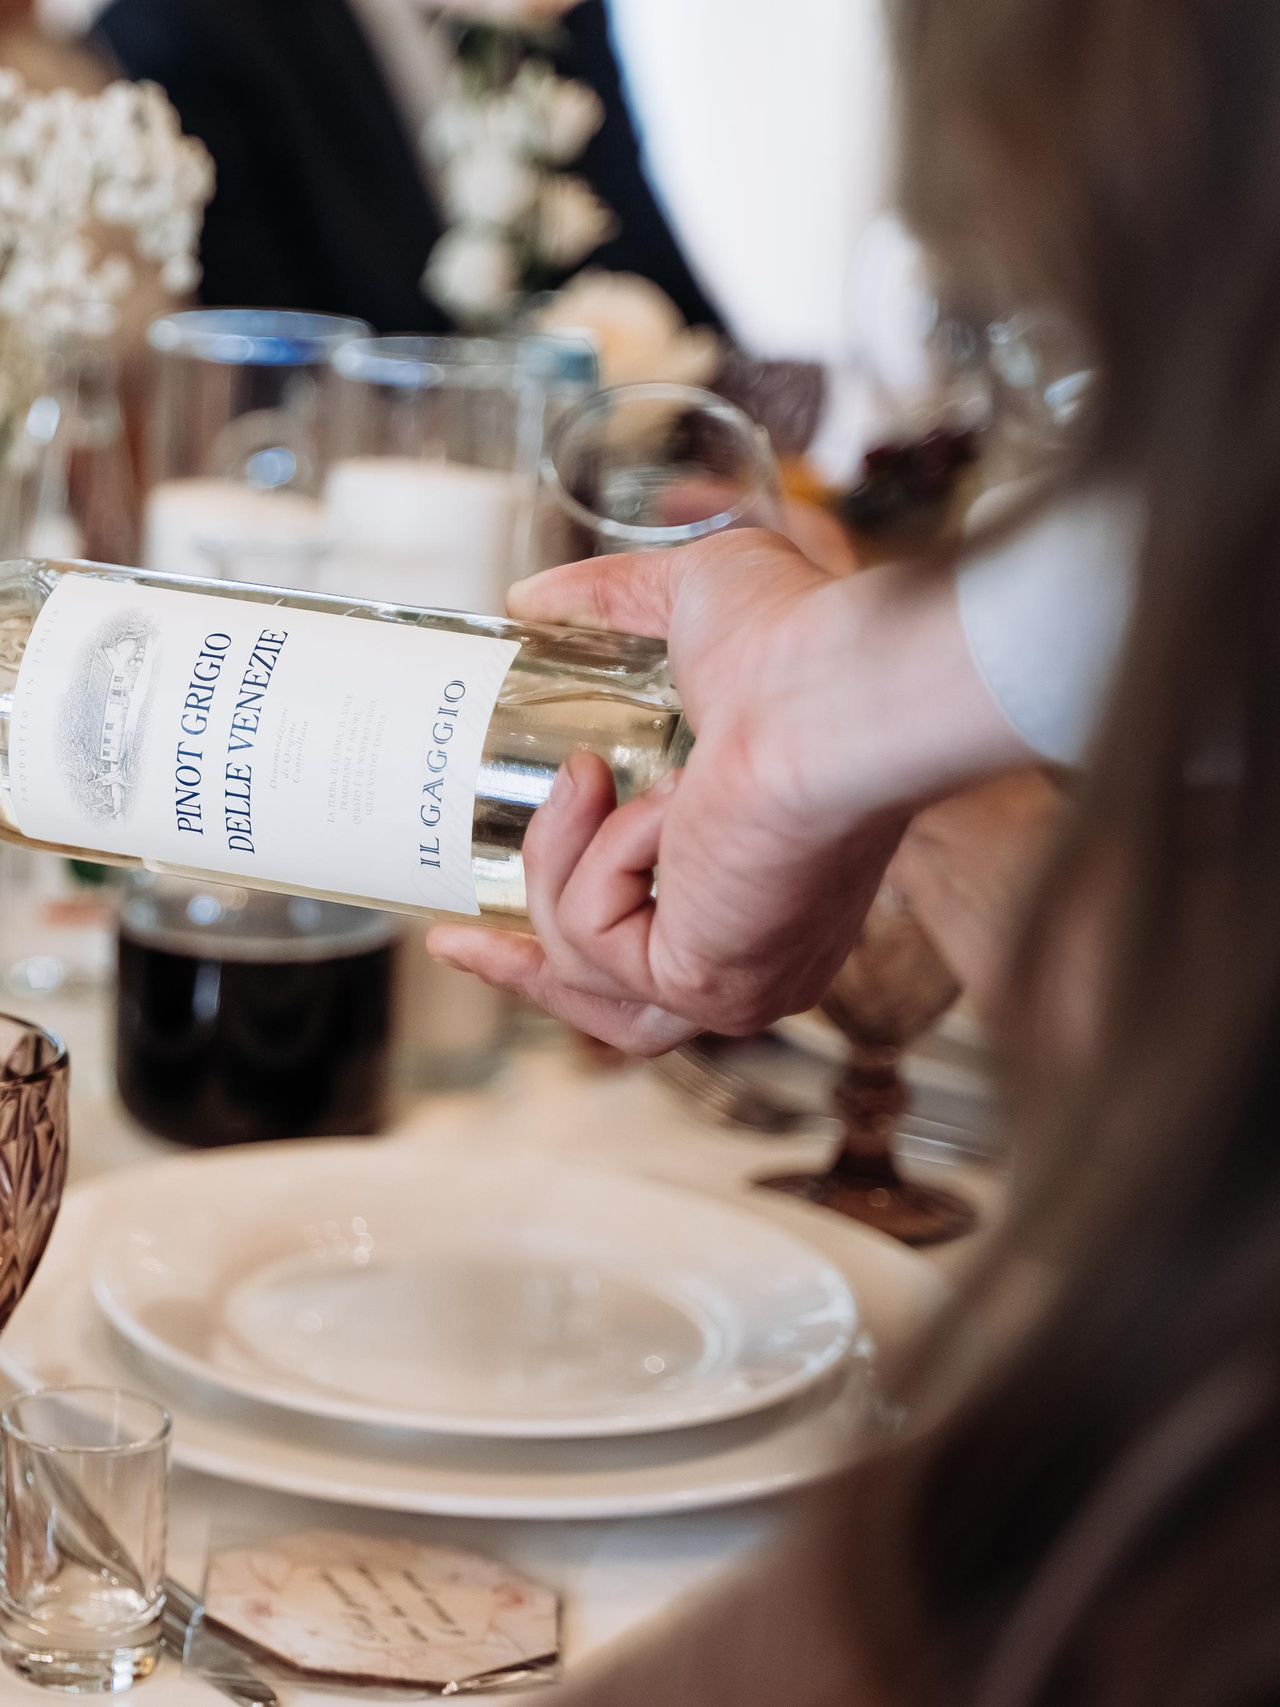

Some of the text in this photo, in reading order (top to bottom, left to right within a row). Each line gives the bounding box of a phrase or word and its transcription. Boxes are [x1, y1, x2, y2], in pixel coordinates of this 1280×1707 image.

[18, 609, 59, 803] PRODOTTO IN ITALIA
[175, 632, 232, 835] PINOT GRIGIO
[224, 628, 289, 854] DELLE VENEZIE
[270, 706, 289, 790] Denominazione
[281, 721, 297, 779] di Origine
[292, 720, 309, 784] Controllata
[357, 727, 371, 765] NOSTRO
[420, 680, 466, 869] IL GAGGIO
[340, 757, 353, 811] TRADIZIONE
[352, 789, 363, 826] QUESTO
